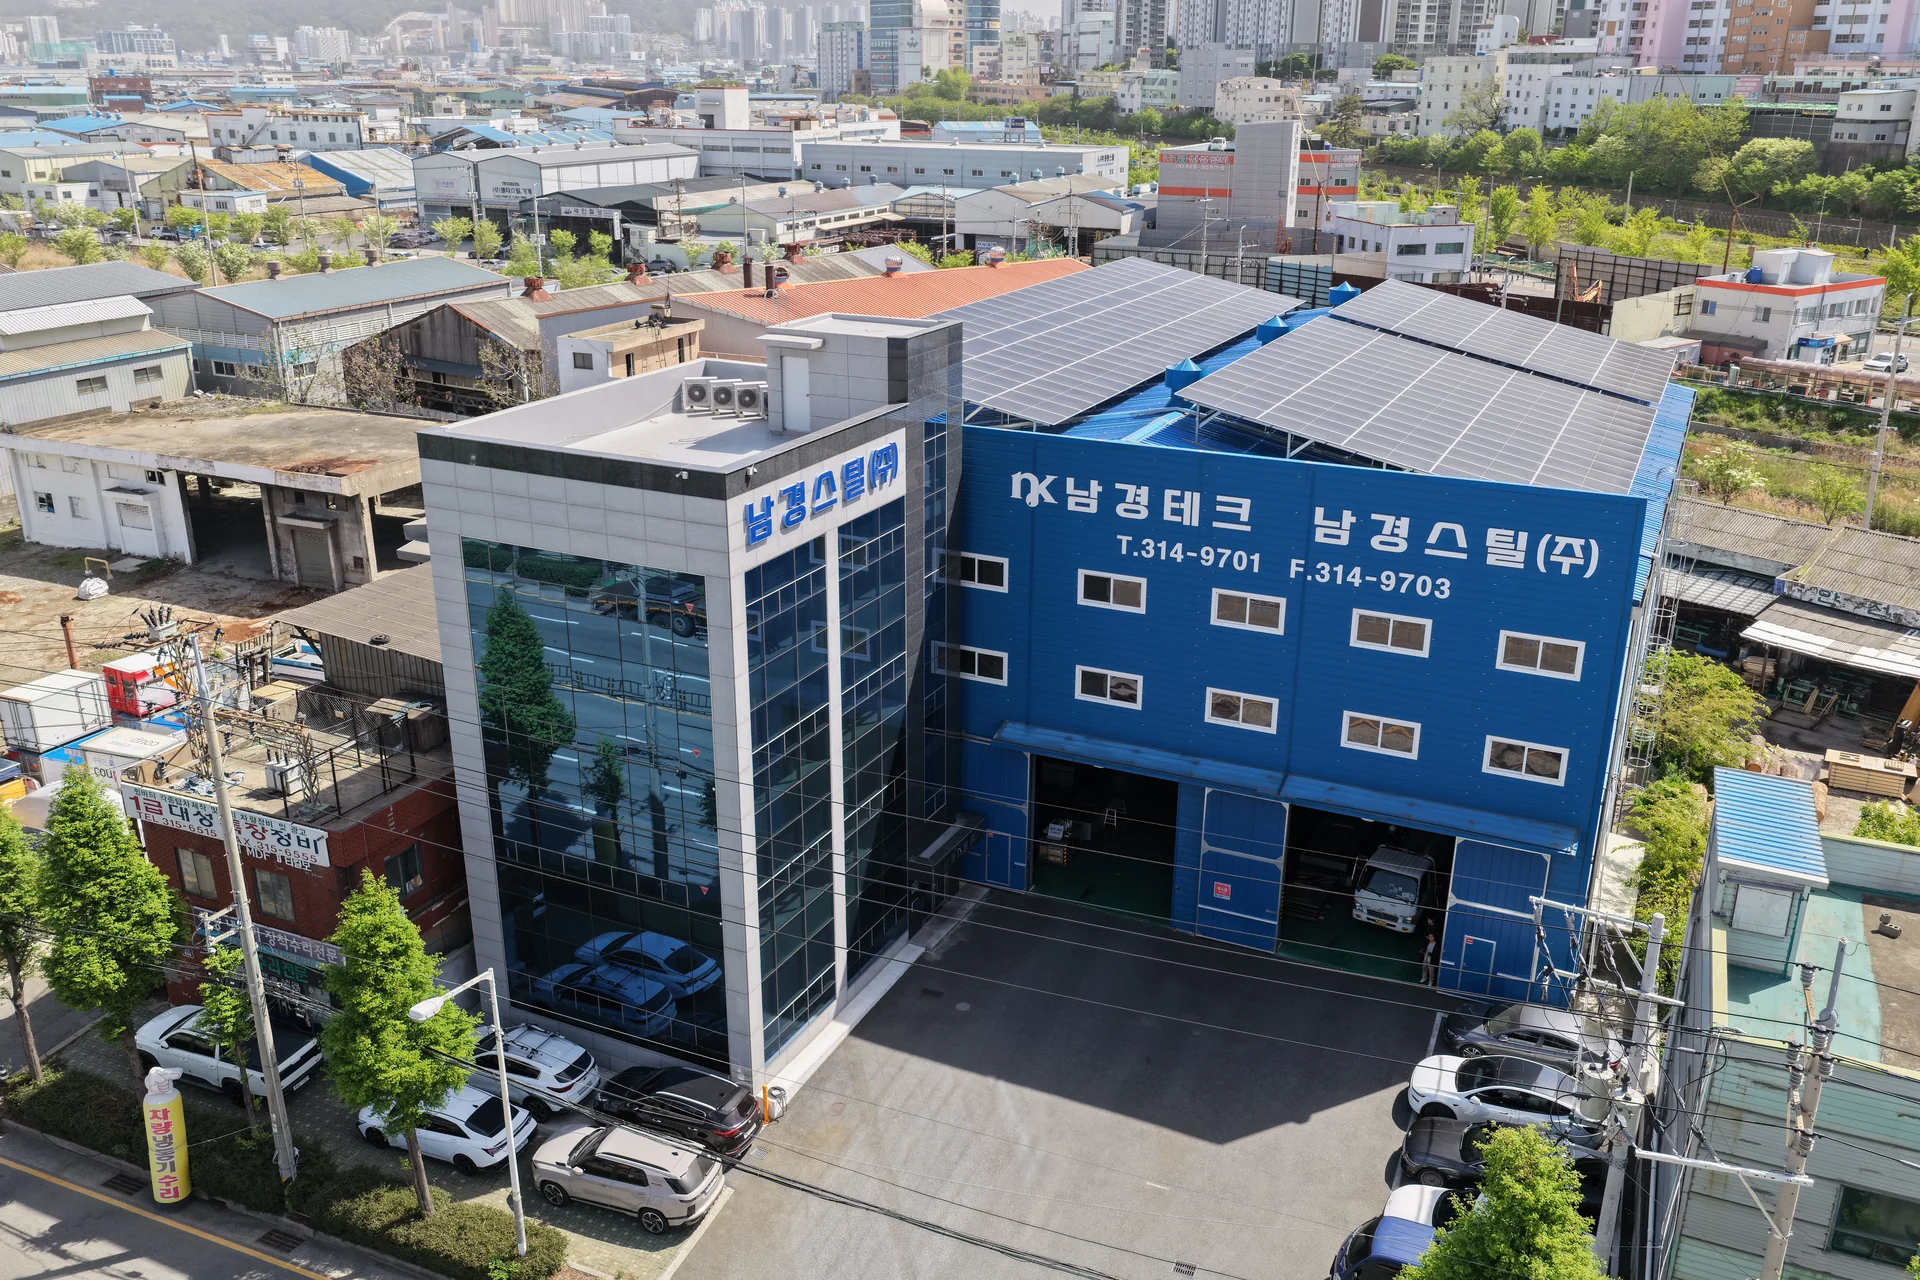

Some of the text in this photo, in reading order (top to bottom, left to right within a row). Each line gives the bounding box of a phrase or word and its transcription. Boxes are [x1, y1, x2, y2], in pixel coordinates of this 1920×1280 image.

[744, 442, 898, 545] 남경스틸(주)
[1066, 477, 1251, 531] 남경테크
[1314, 507, 1598, 578] 남경스틸(주)
[1117, 535, 1450, 598] T.314-9701 F.314-9703
[137, 811, 158, 824] TEL
[163, 817, 217, 838] 315-6515
